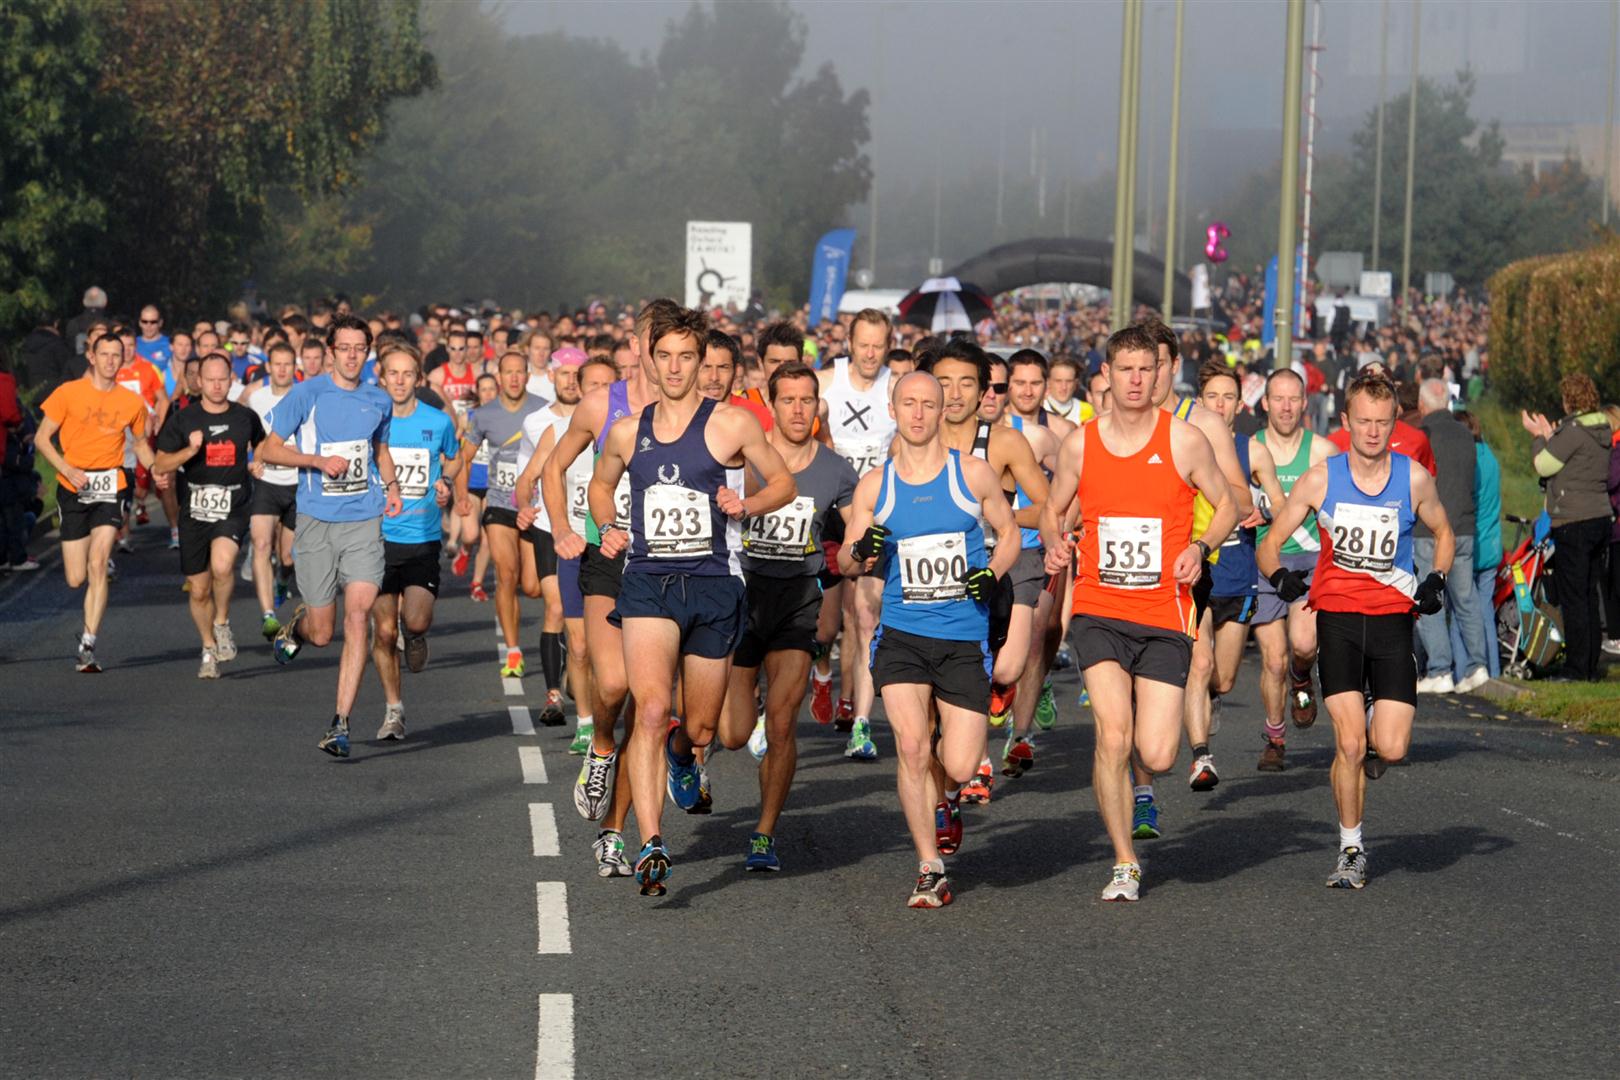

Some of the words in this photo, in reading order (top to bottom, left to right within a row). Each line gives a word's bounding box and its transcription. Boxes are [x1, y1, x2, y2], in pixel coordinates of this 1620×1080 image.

[194, 488, 229, 510] 1656
[651, 507, 702, 537] 233
[751, 514, 807, 543] 4251
[1105, 540, 1151, 570] 535
[1334, 525, 1396, 557] 2816
[904, 554, 966, 585] 1090
